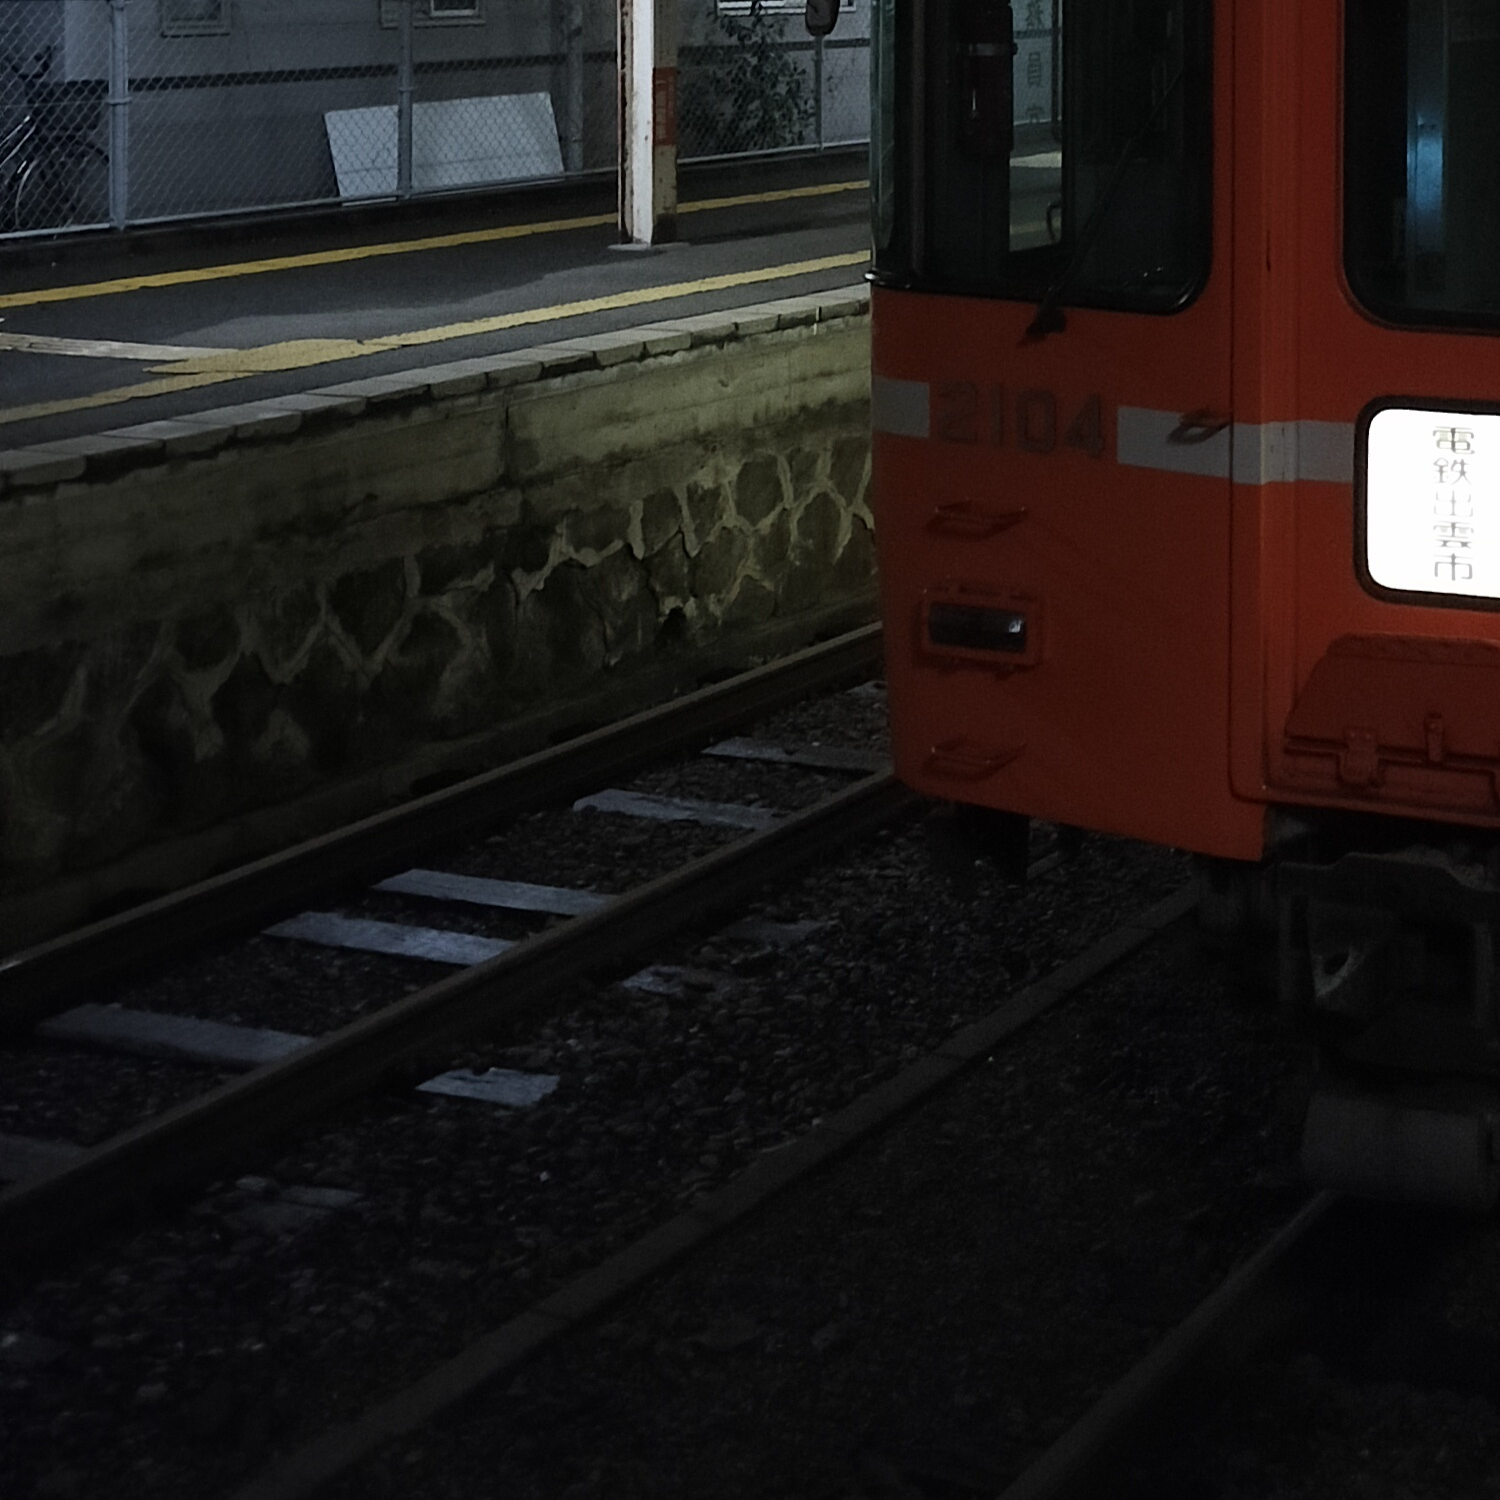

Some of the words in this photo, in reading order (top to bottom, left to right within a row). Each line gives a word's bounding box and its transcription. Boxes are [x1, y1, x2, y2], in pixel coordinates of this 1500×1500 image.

[937, 379, 1107, 460] 2104
[1432, 425, 1476, 582] 電鉄出雲市
